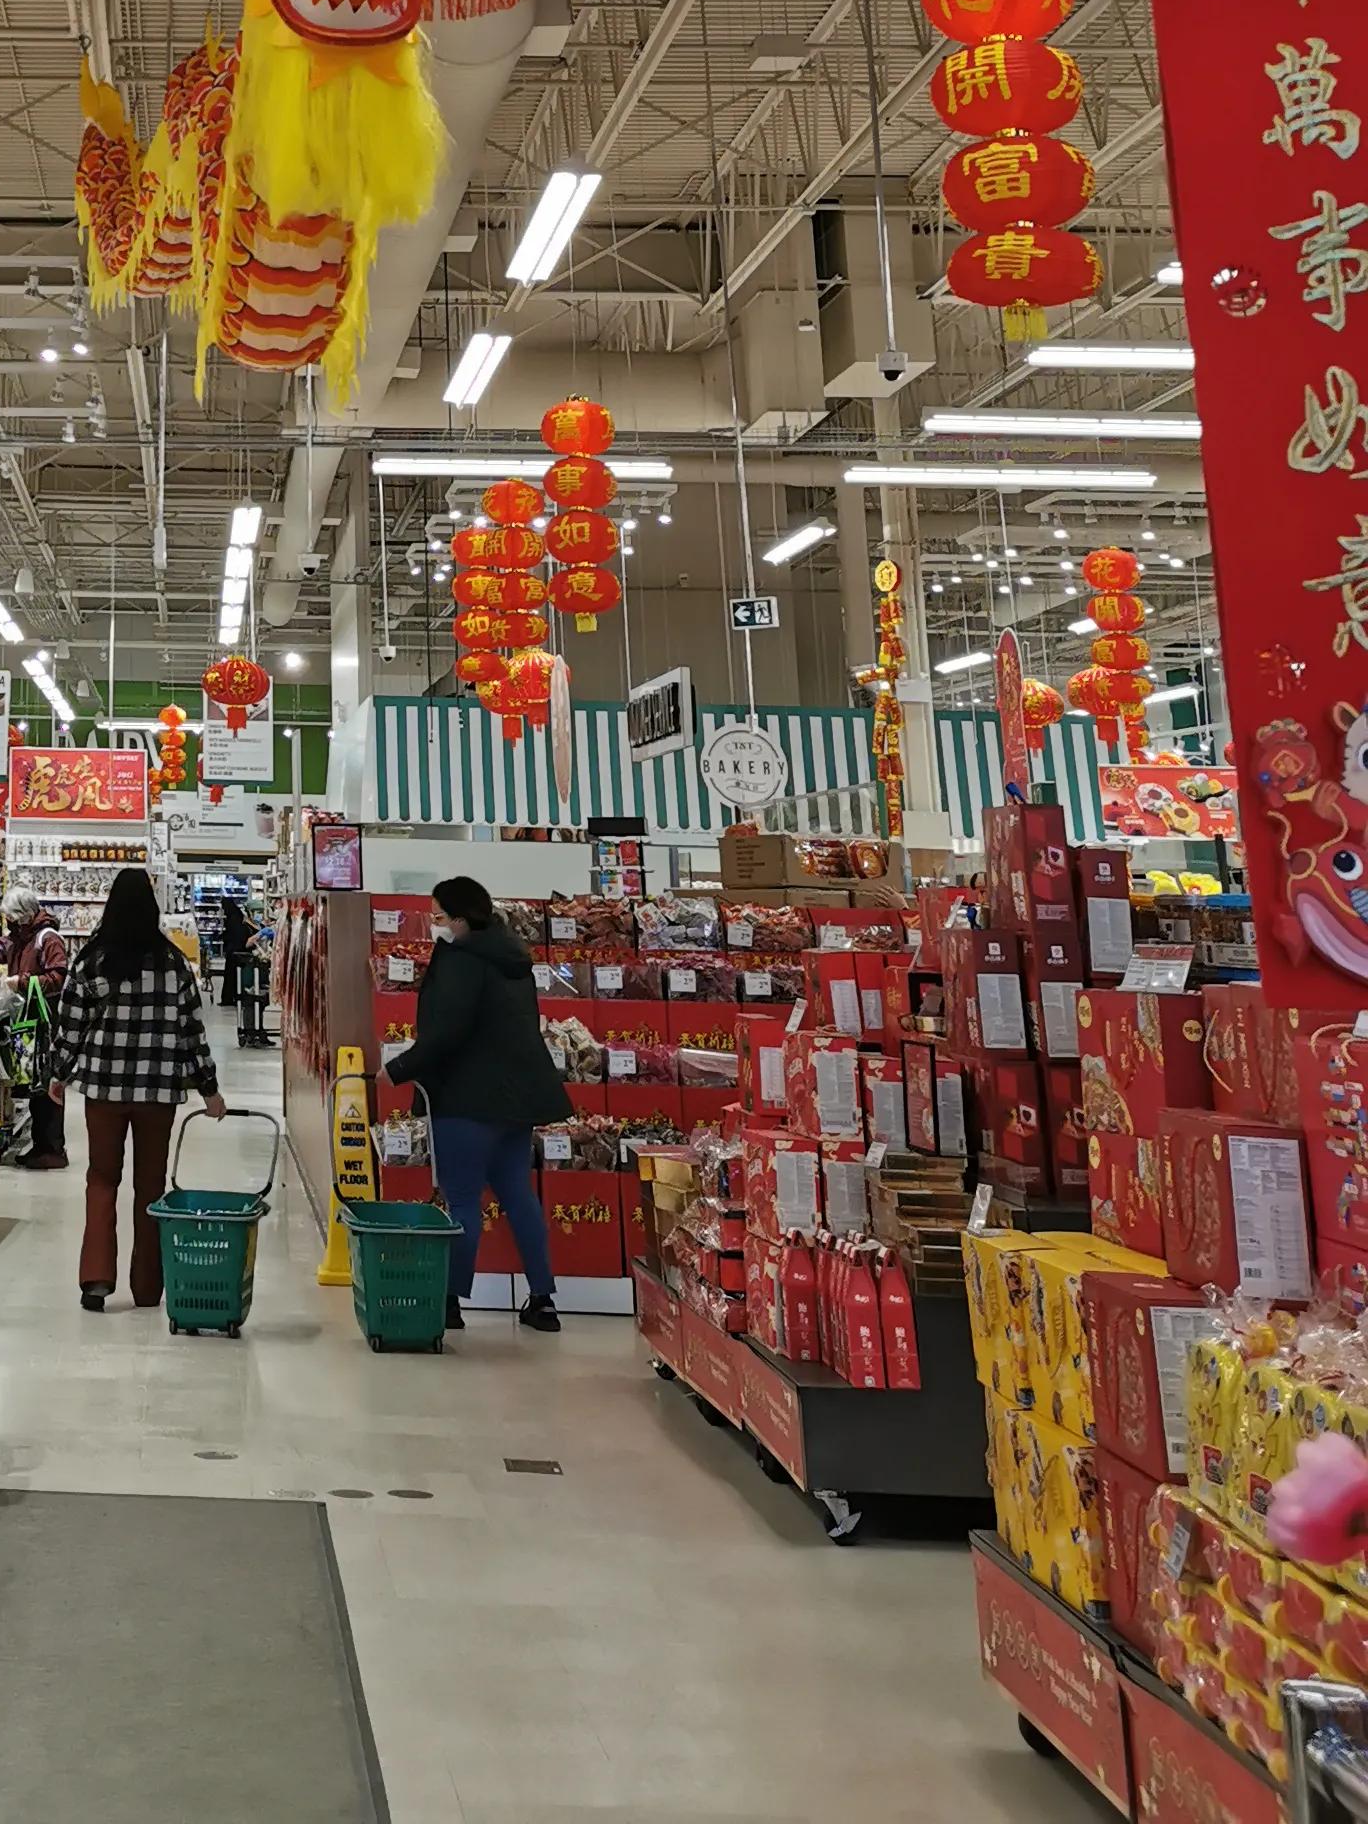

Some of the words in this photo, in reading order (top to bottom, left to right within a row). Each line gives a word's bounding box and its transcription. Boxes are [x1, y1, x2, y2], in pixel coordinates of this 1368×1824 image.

[551, 409, 602, 601] 萬事如意
[703, 759, 785, 775] BAKERY
[344, 1160, 364, 1170] WET
[339, 1174, 369, 1185] FLOOR
